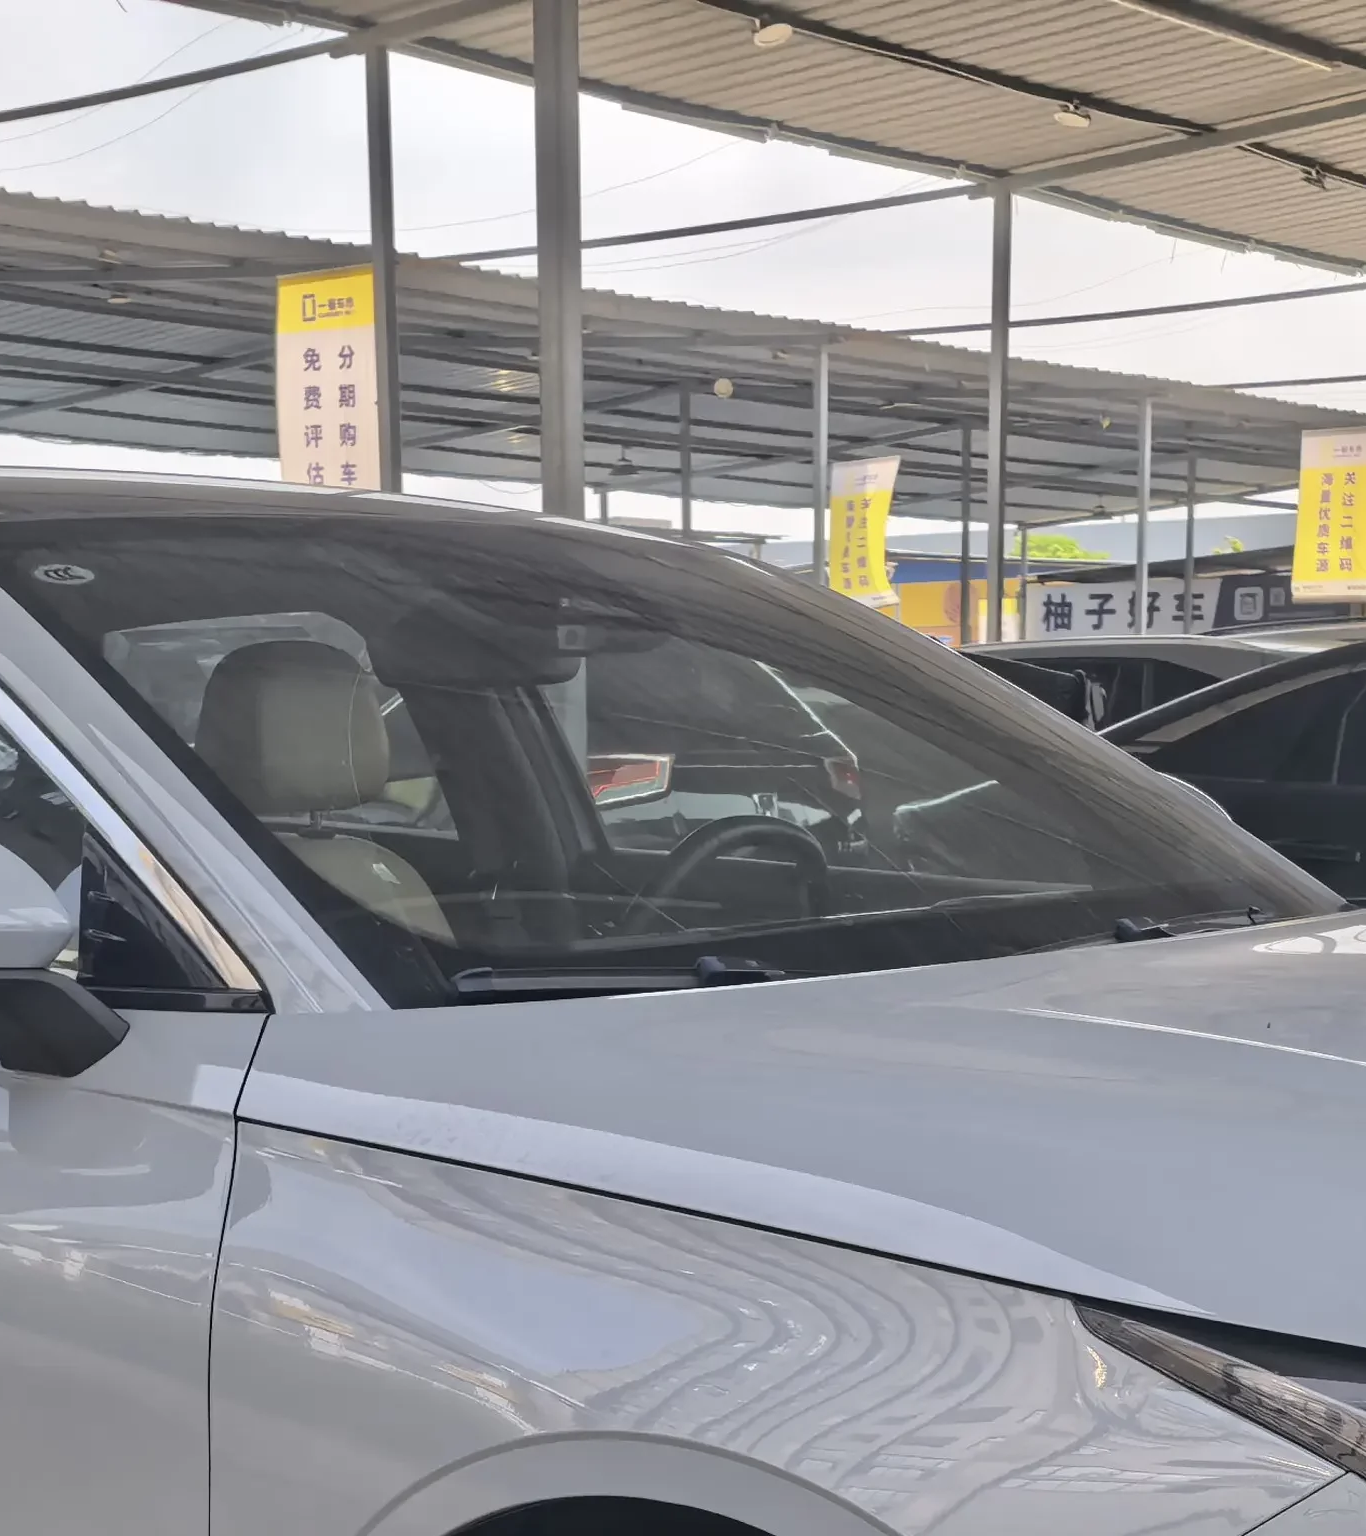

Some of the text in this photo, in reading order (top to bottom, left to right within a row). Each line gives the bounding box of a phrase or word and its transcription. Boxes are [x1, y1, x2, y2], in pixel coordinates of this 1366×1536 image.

[303, 348, 324, 485] 免费评估
[338, 345, 357, 486] 分期购车
[1042, 590, 1204, 632] 柚子好车
